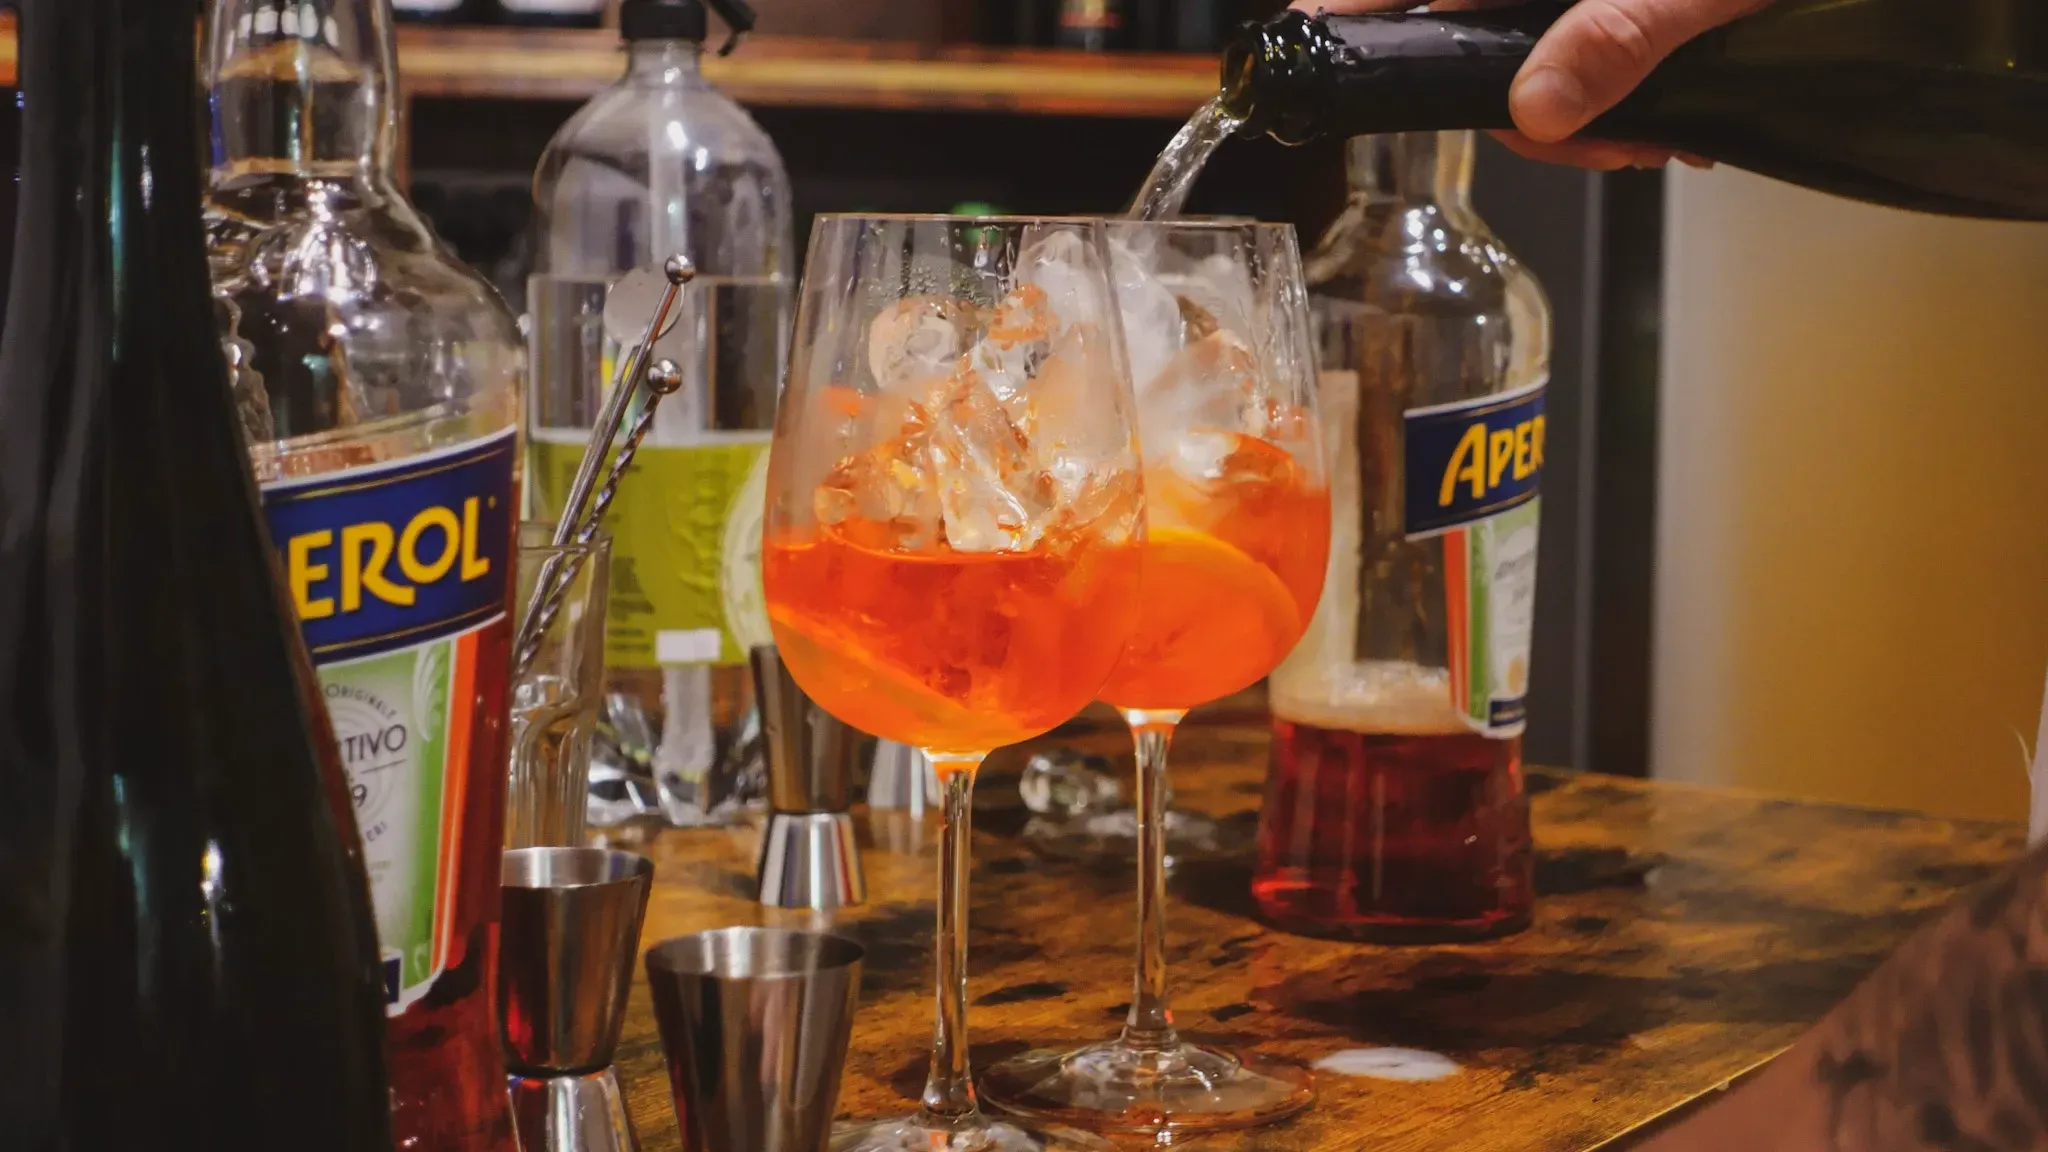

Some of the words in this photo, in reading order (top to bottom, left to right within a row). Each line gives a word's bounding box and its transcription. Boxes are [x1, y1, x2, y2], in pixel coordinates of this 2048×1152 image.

[288, 496, 491, 621] EROL
[344, 723, 407, 763] TIVO
[351, 784, 368, 808] 9
